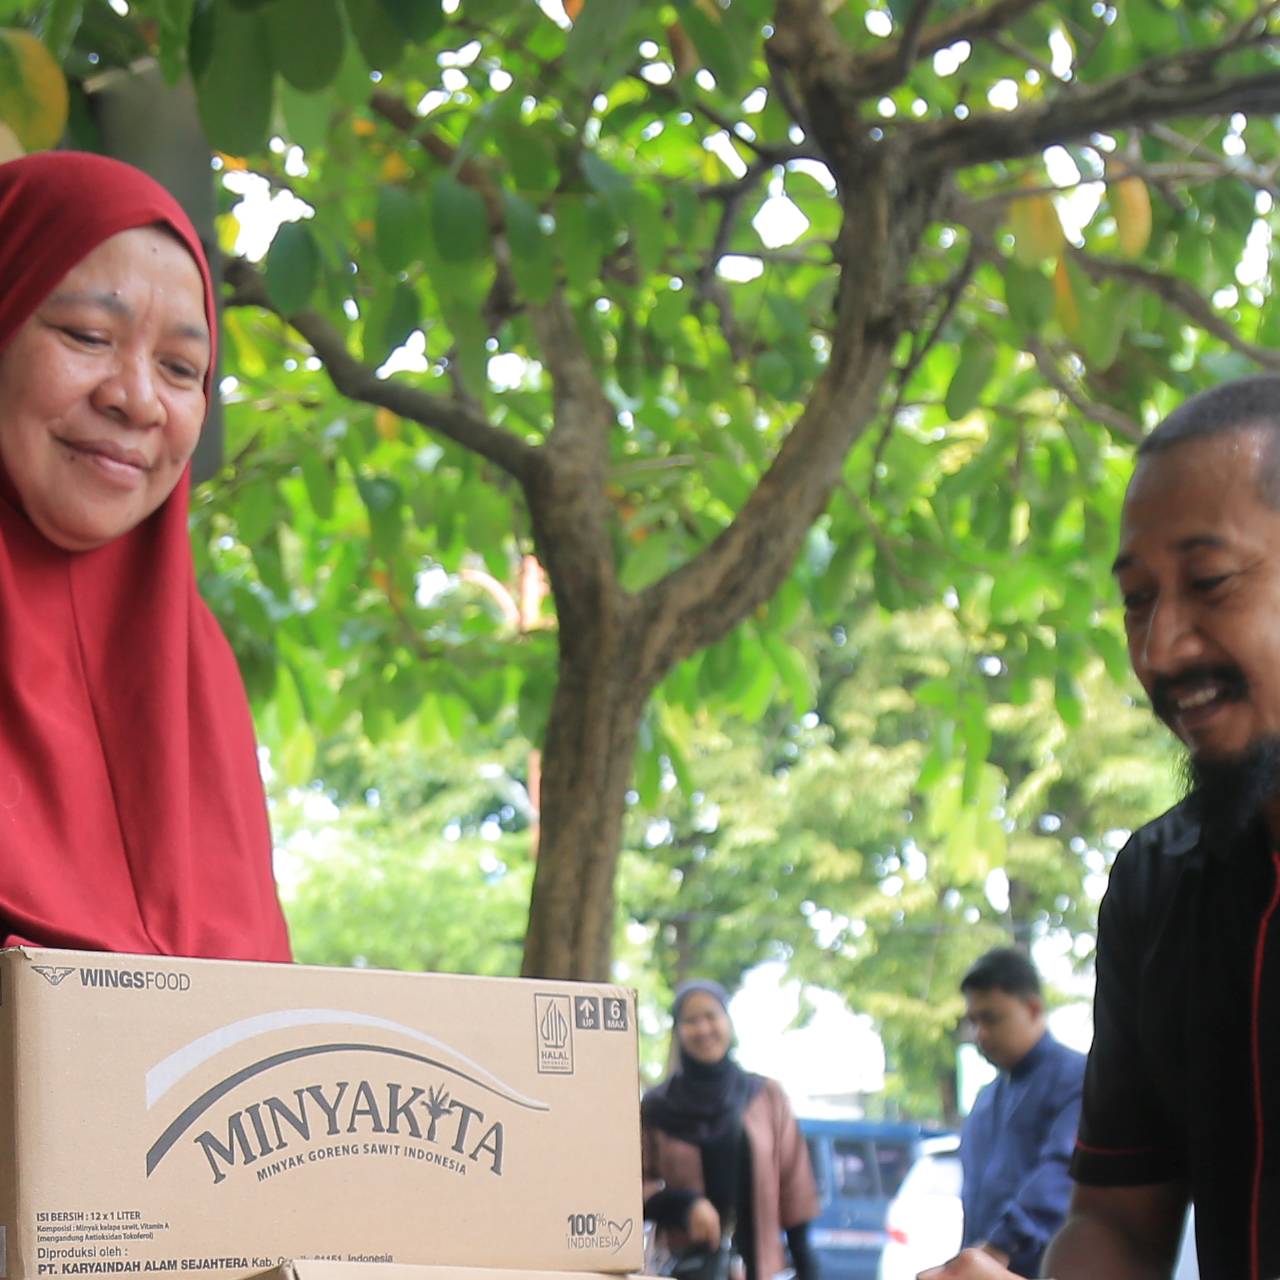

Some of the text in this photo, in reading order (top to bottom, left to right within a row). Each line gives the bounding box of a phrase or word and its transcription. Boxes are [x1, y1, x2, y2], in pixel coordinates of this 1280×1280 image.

[80, 967, 191, 993] WINGSFOOD
[610, 1000, 621, 1020] 6
[583, 1019, 593, 1027] UP
[607, 1020, 625, 1028] MAX
[541, 1051, 569, 1060] HALAL
[193, 1080, 505, 1185] MINYAKITA
[256, 1143, 467, 1182] MINYAK GORENG SAWIT INDONESIA
[36, 1212, 49, 1222] ISI
[51, 1212, 84, 1221] BERSIH
[91, 1212, 102, 1221] 12
[117, 1211, 141, 1220] LITER
[567, 1212, 607, 1236] 100%
[567, 1236, 620, 1248] INDONESIA
[37, 1246, 122, 1260] Diproduksi oleh
[38, 1264, 58, 1275] PT.
[62, 1262, 141, 1274] KARYAINDAH
[144, 1260, 177, 1272] ALAM
[181, 1256, 248, 1271] SEJAHTERA
[251, 1256, 274, 1268] Kab.
